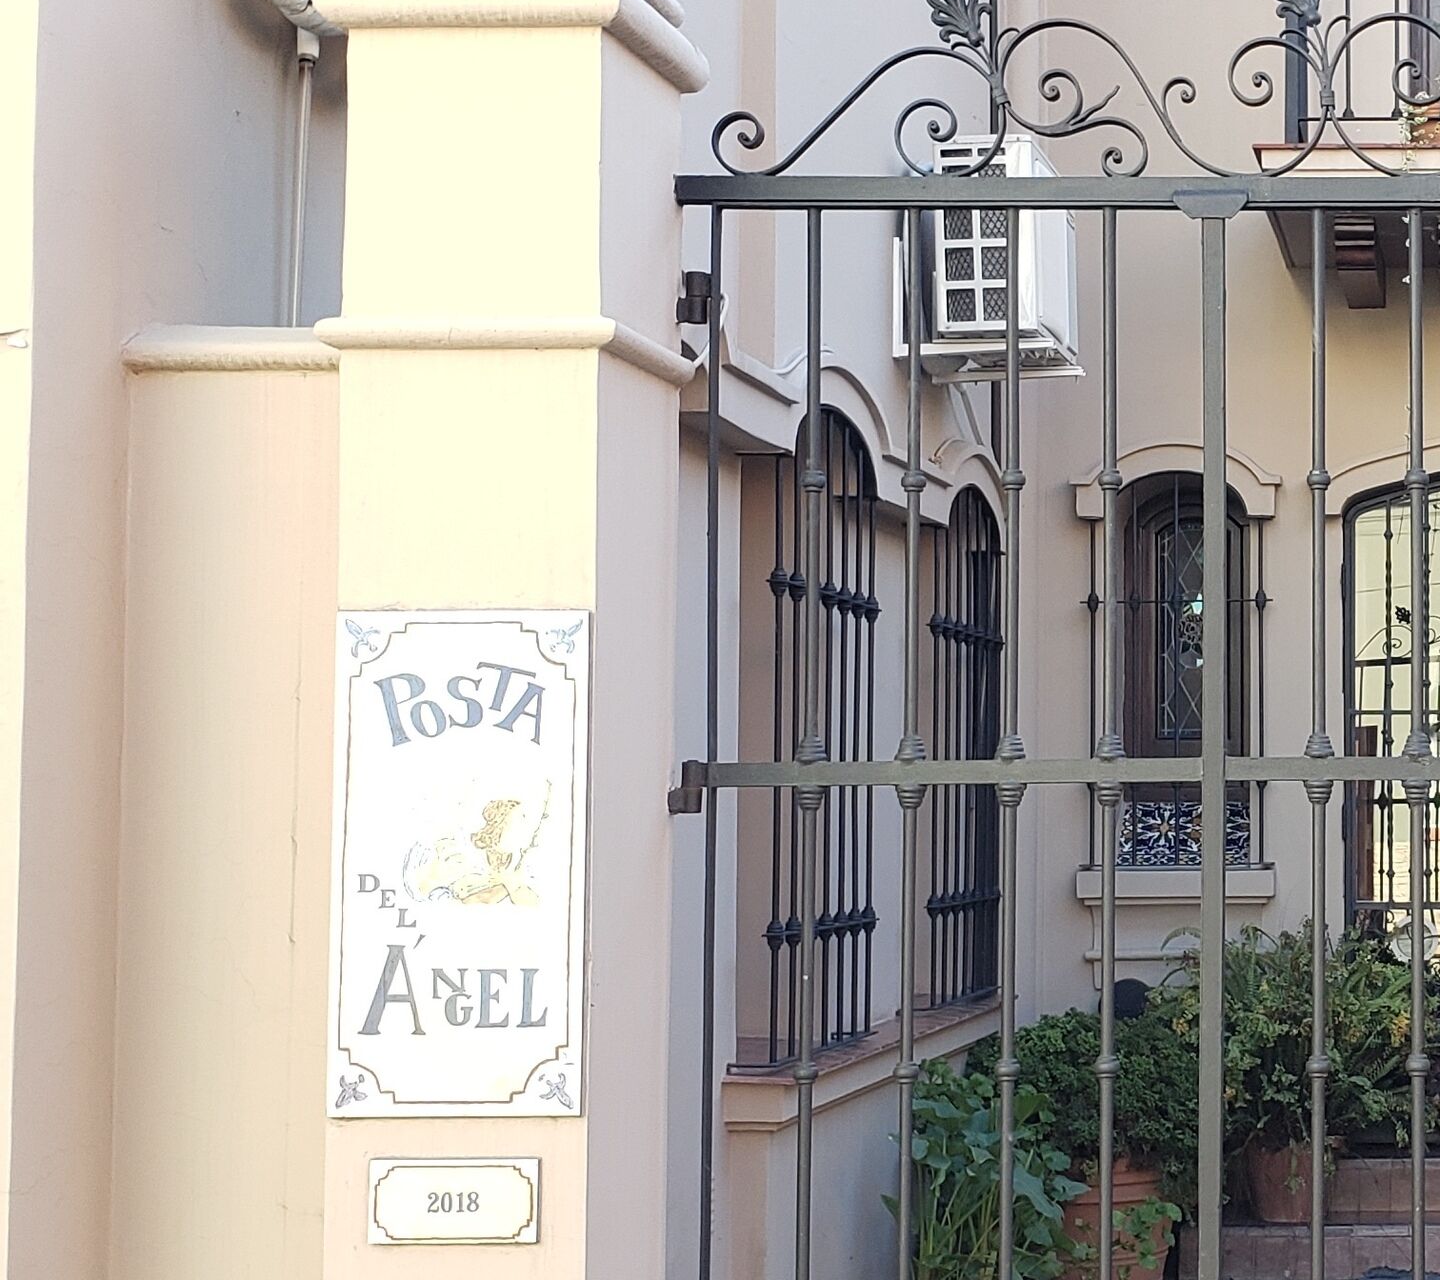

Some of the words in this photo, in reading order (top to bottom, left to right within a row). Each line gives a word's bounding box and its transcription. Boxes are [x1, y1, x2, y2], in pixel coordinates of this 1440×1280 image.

[373, 661, 546, 747] POSTA
[357, 873, 417, 928] DEL
[357, 934, 549, 1035] ÁNGEL
[427, 1191, 480, 1213] 2018
